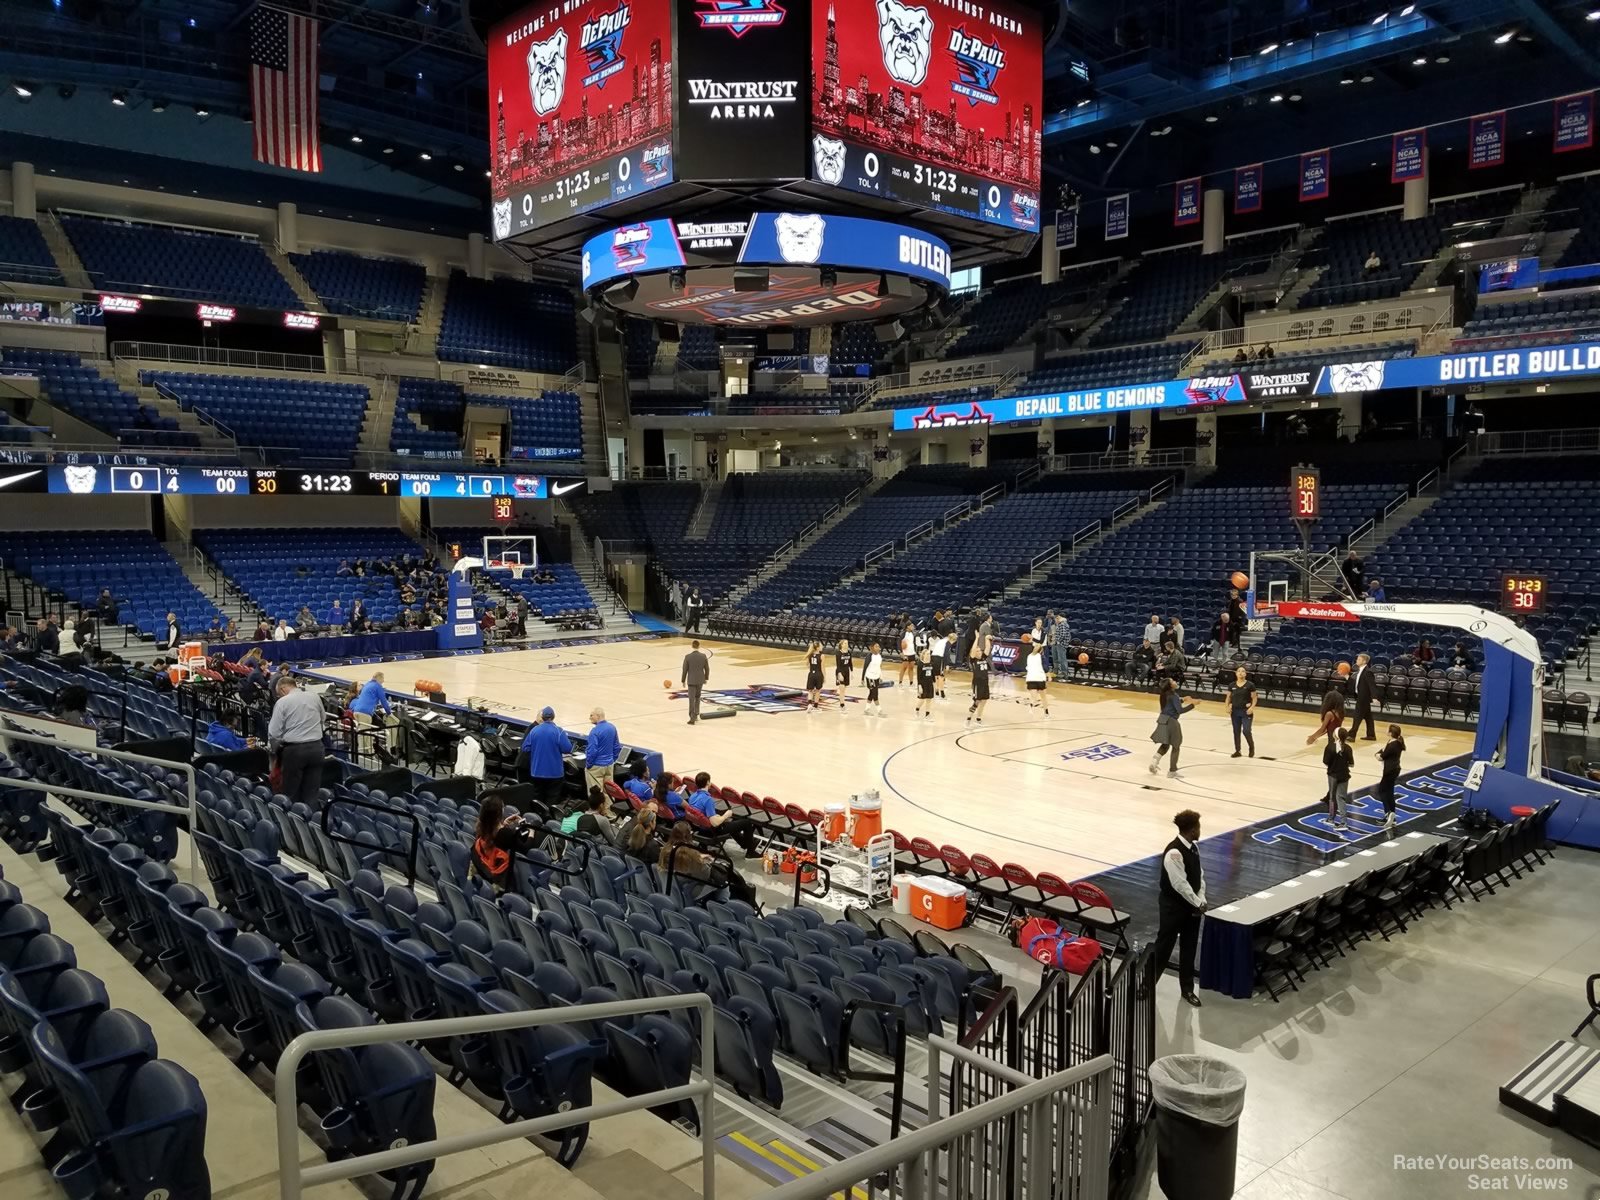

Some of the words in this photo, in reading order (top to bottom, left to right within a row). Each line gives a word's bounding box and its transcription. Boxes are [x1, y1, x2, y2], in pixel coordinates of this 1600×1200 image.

[506, 15, 545, 47] WELCOME
[549, 7, 559, 23] TO
[989, 12, 1023, 36] ARENA
[688, 79, 798, 99] WINTRUST
[953, 84, 970, 96] BLUE
[971, 88, 998, 104] DEMONS
[710, 104, 775, 119] ARENA
[1560, 114, 1586, 125] NCAA
[1475, 132, 1499, 143] NCAA
[1397, 148, 1420, 158] NCAA
[618, 156, 631, 182] 0
[863, 152, 879, 178] 0
[902, 170, 911, 180] 00
[913, 164, 957, 192] 31:23
[1304, 168, 1324, 178] NCAA
[556, 170, 591, 200] 31:23
[616, 185, 627, 195] TOL
[627, 183, 632, 191] 4
[858, 177, 872, 189] TOL
[874, 182, 879, 191] 4
[1239, 182, 1258, 191] NCAA
[569, 199, 578, 208] 1st
[931, 192, 941, 202] 1st
[988, 185, 1001, 208] 0
[522, 193, 533, 216] 0
[1178, 206, 1197, 217] 1945
[984, 208, 996, 218] TOL
[520, 219, 529, 228] TOL
[677, 222, 748, 237] WINTRUST
[690, 238, 733, 249] ARENA
[899, 234, 946, 274] BUTLER
[1440, 352, 1520, 381] BUTLER
[1250, 372, 1310, 386] WINTRUST
[1261, 386, 1297, 397] ARENA
[1015, 397, 1063, 417] DEPAUL
[1068, 393, 1101, 413] BLUE
[1106, 386, 1166, 409] DEMONS
[165, 468, 180, 476] TOL
[202, 469, 222, 477] TEAM
[222, 470, 248, 478] FOULS
[256, 470, 276, 478] SHOT
[369, 472, 399, 481] PERIOD
[402, 473, 419, 481] TEAM
[129, 472, 143, 489] 0
[166, 476, 180, 492] 4
[216, 477, 236, 493] 00
[257, 479, 277, 493] 30
[300, 474, 352, 492] 31:23
[381, 481, 388, 494] 1
[482, 479, 493, 494] 0
[412, 481, 431, 495] 00
[456, 482, 466, 496] 4
[1300, 491, 1313, 513] 30
[497, 506, 510, 517] 30
[1507, 579, 1542, 592] 31:23
[1515, 593, 1533, 607] 30
[1363, 603, 1396, 613] SPALDING
[1086, 748, 1133, 762] BIG
[922, 894, 933, 910] G
